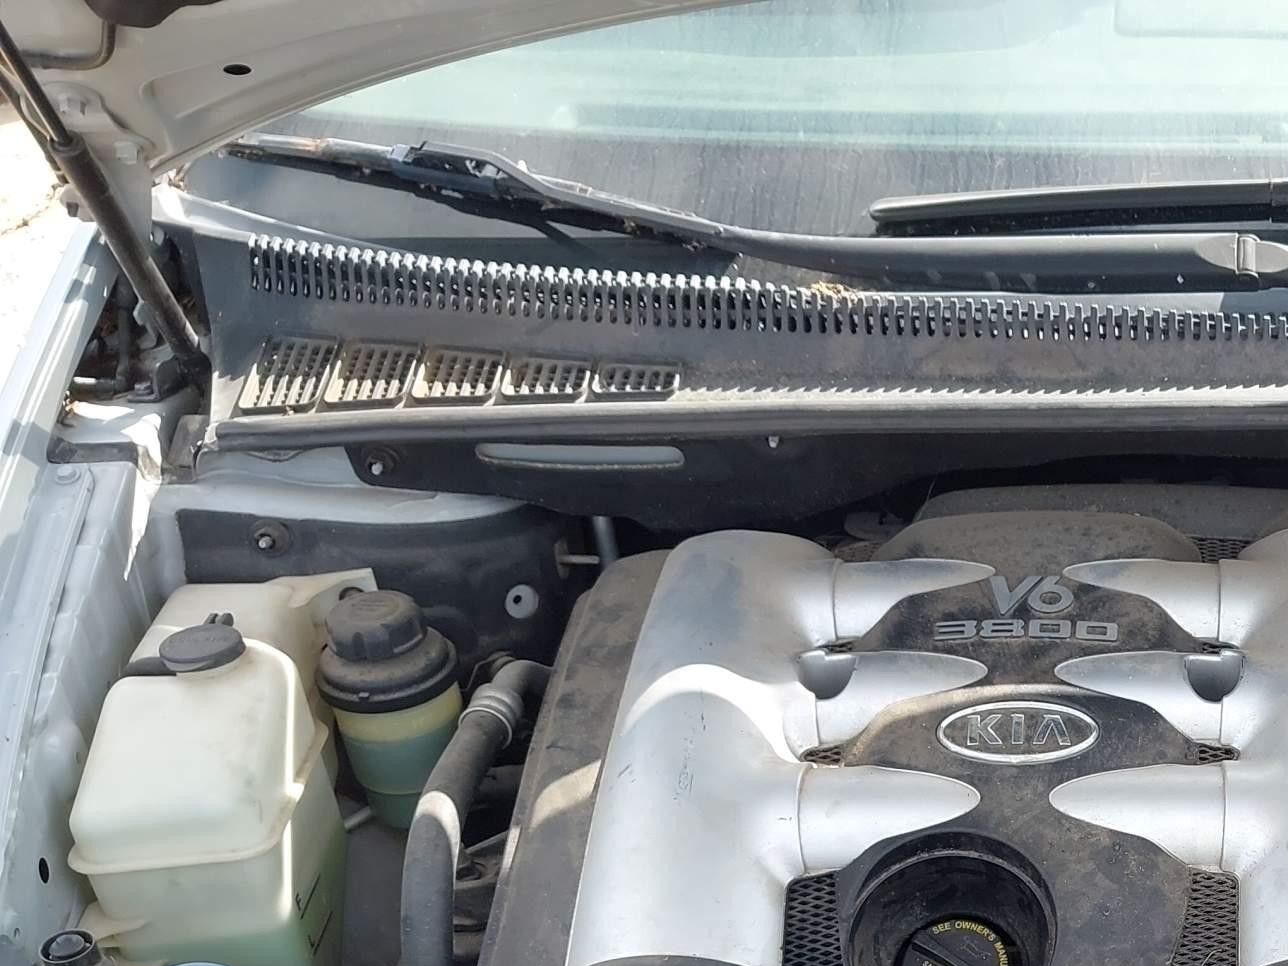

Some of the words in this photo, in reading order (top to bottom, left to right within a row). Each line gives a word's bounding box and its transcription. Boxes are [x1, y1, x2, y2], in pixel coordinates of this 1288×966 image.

[989, 575, 1074, 616] V6
[933, 618, 1119, 642] 3800
[966, 713, 1073, 747] KIA
[931, 921, 952, 935] SEE
[954, 920, 997, 941] OWNER'S
